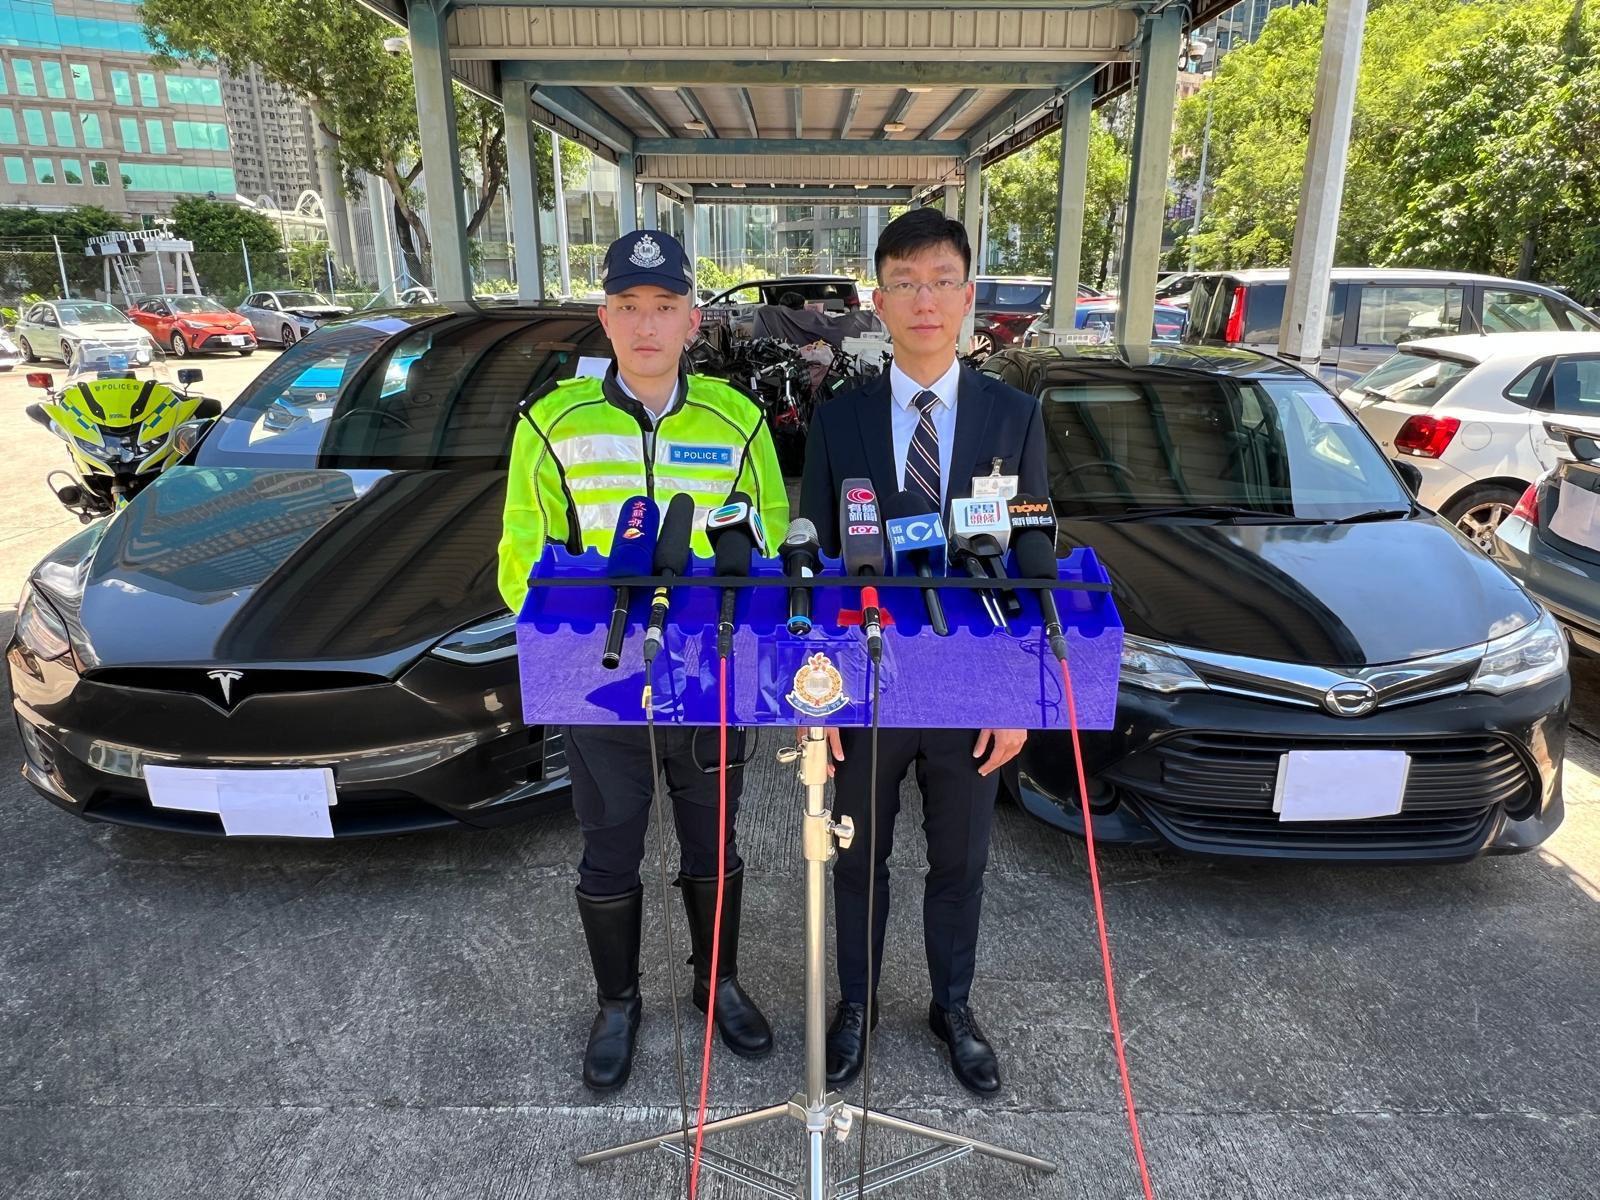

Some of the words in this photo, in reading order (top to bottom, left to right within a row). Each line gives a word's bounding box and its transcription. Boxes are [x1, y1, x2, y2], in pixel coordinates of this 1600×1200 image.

[102, 383, 131, 391] POLICE
[684, 451, 718, 460] POLICE
[1008, 502, 1048, 513] now
